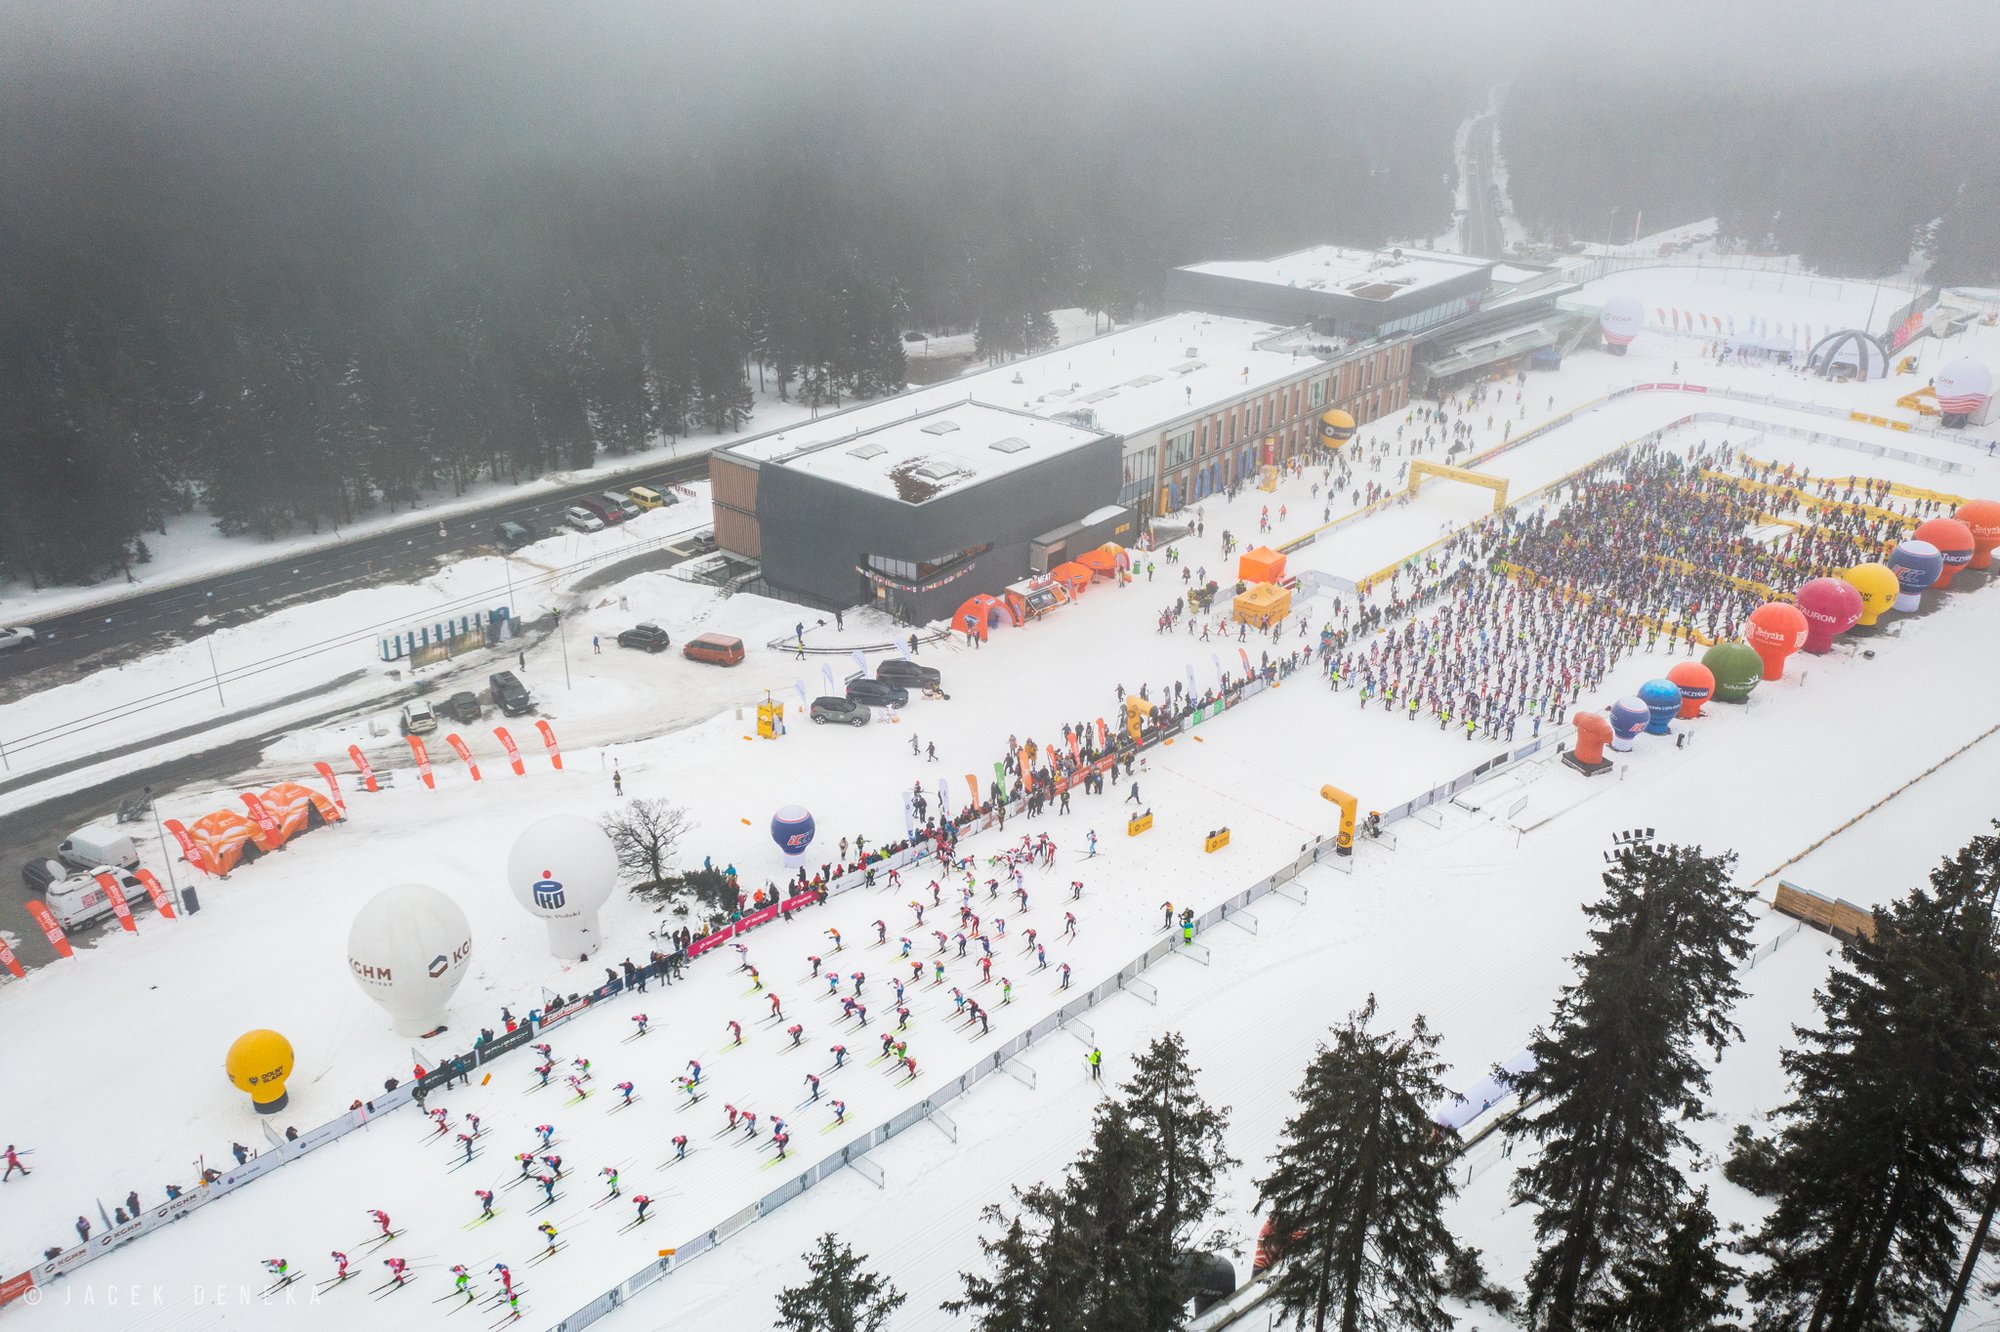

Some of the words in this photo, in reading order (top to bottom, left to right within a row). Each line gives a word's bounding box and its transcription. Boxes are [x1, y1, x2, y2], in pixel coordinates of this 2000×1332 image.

[1797, 604, 1837, 624] TAURON
[1755, 626, 1785, 641] Jedynka
[170, 1194, 197, 1211] KGHM
[114, 1221, 142, 1239] KGHM
[58, 1249, 87, 1266] KGHM
